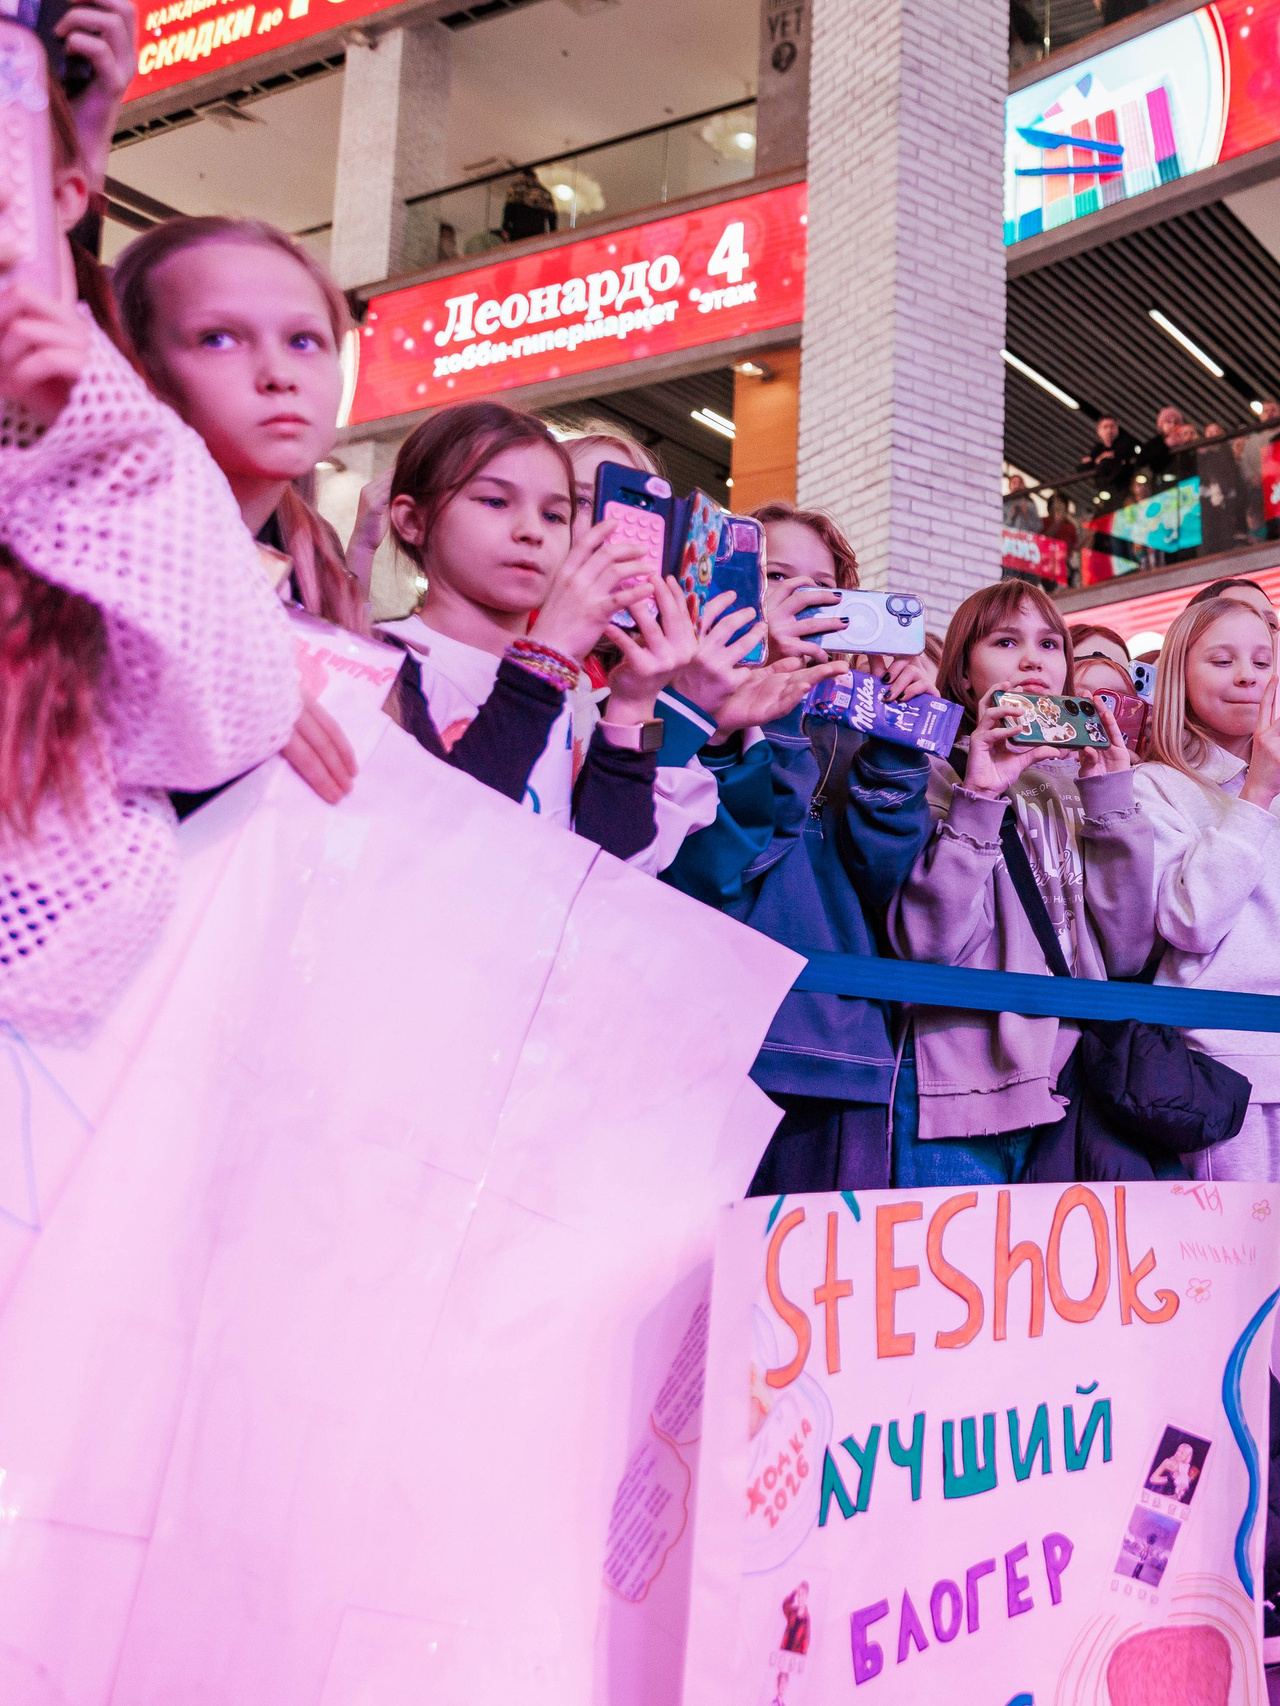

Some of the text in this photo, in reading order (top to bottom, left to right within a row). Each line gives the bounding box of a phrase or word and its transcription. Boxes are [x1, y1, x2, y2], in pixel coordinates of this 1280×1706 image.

[138, 5, 256, 75] СКИДКИ
[257, 8, 283, 34] до
[433, 281, 757, 377] хобби-гипермаркет этаж
[434, 222, 749, 347] Леонардо 4
[851, 676, 877, 733] Milka
[763, 1453, 810, 1529] 2026
[818, 1380, 1112, 1528] ЛУЧШИЙ
[850, 1532, 1075, 1686] БЛОГЕР
